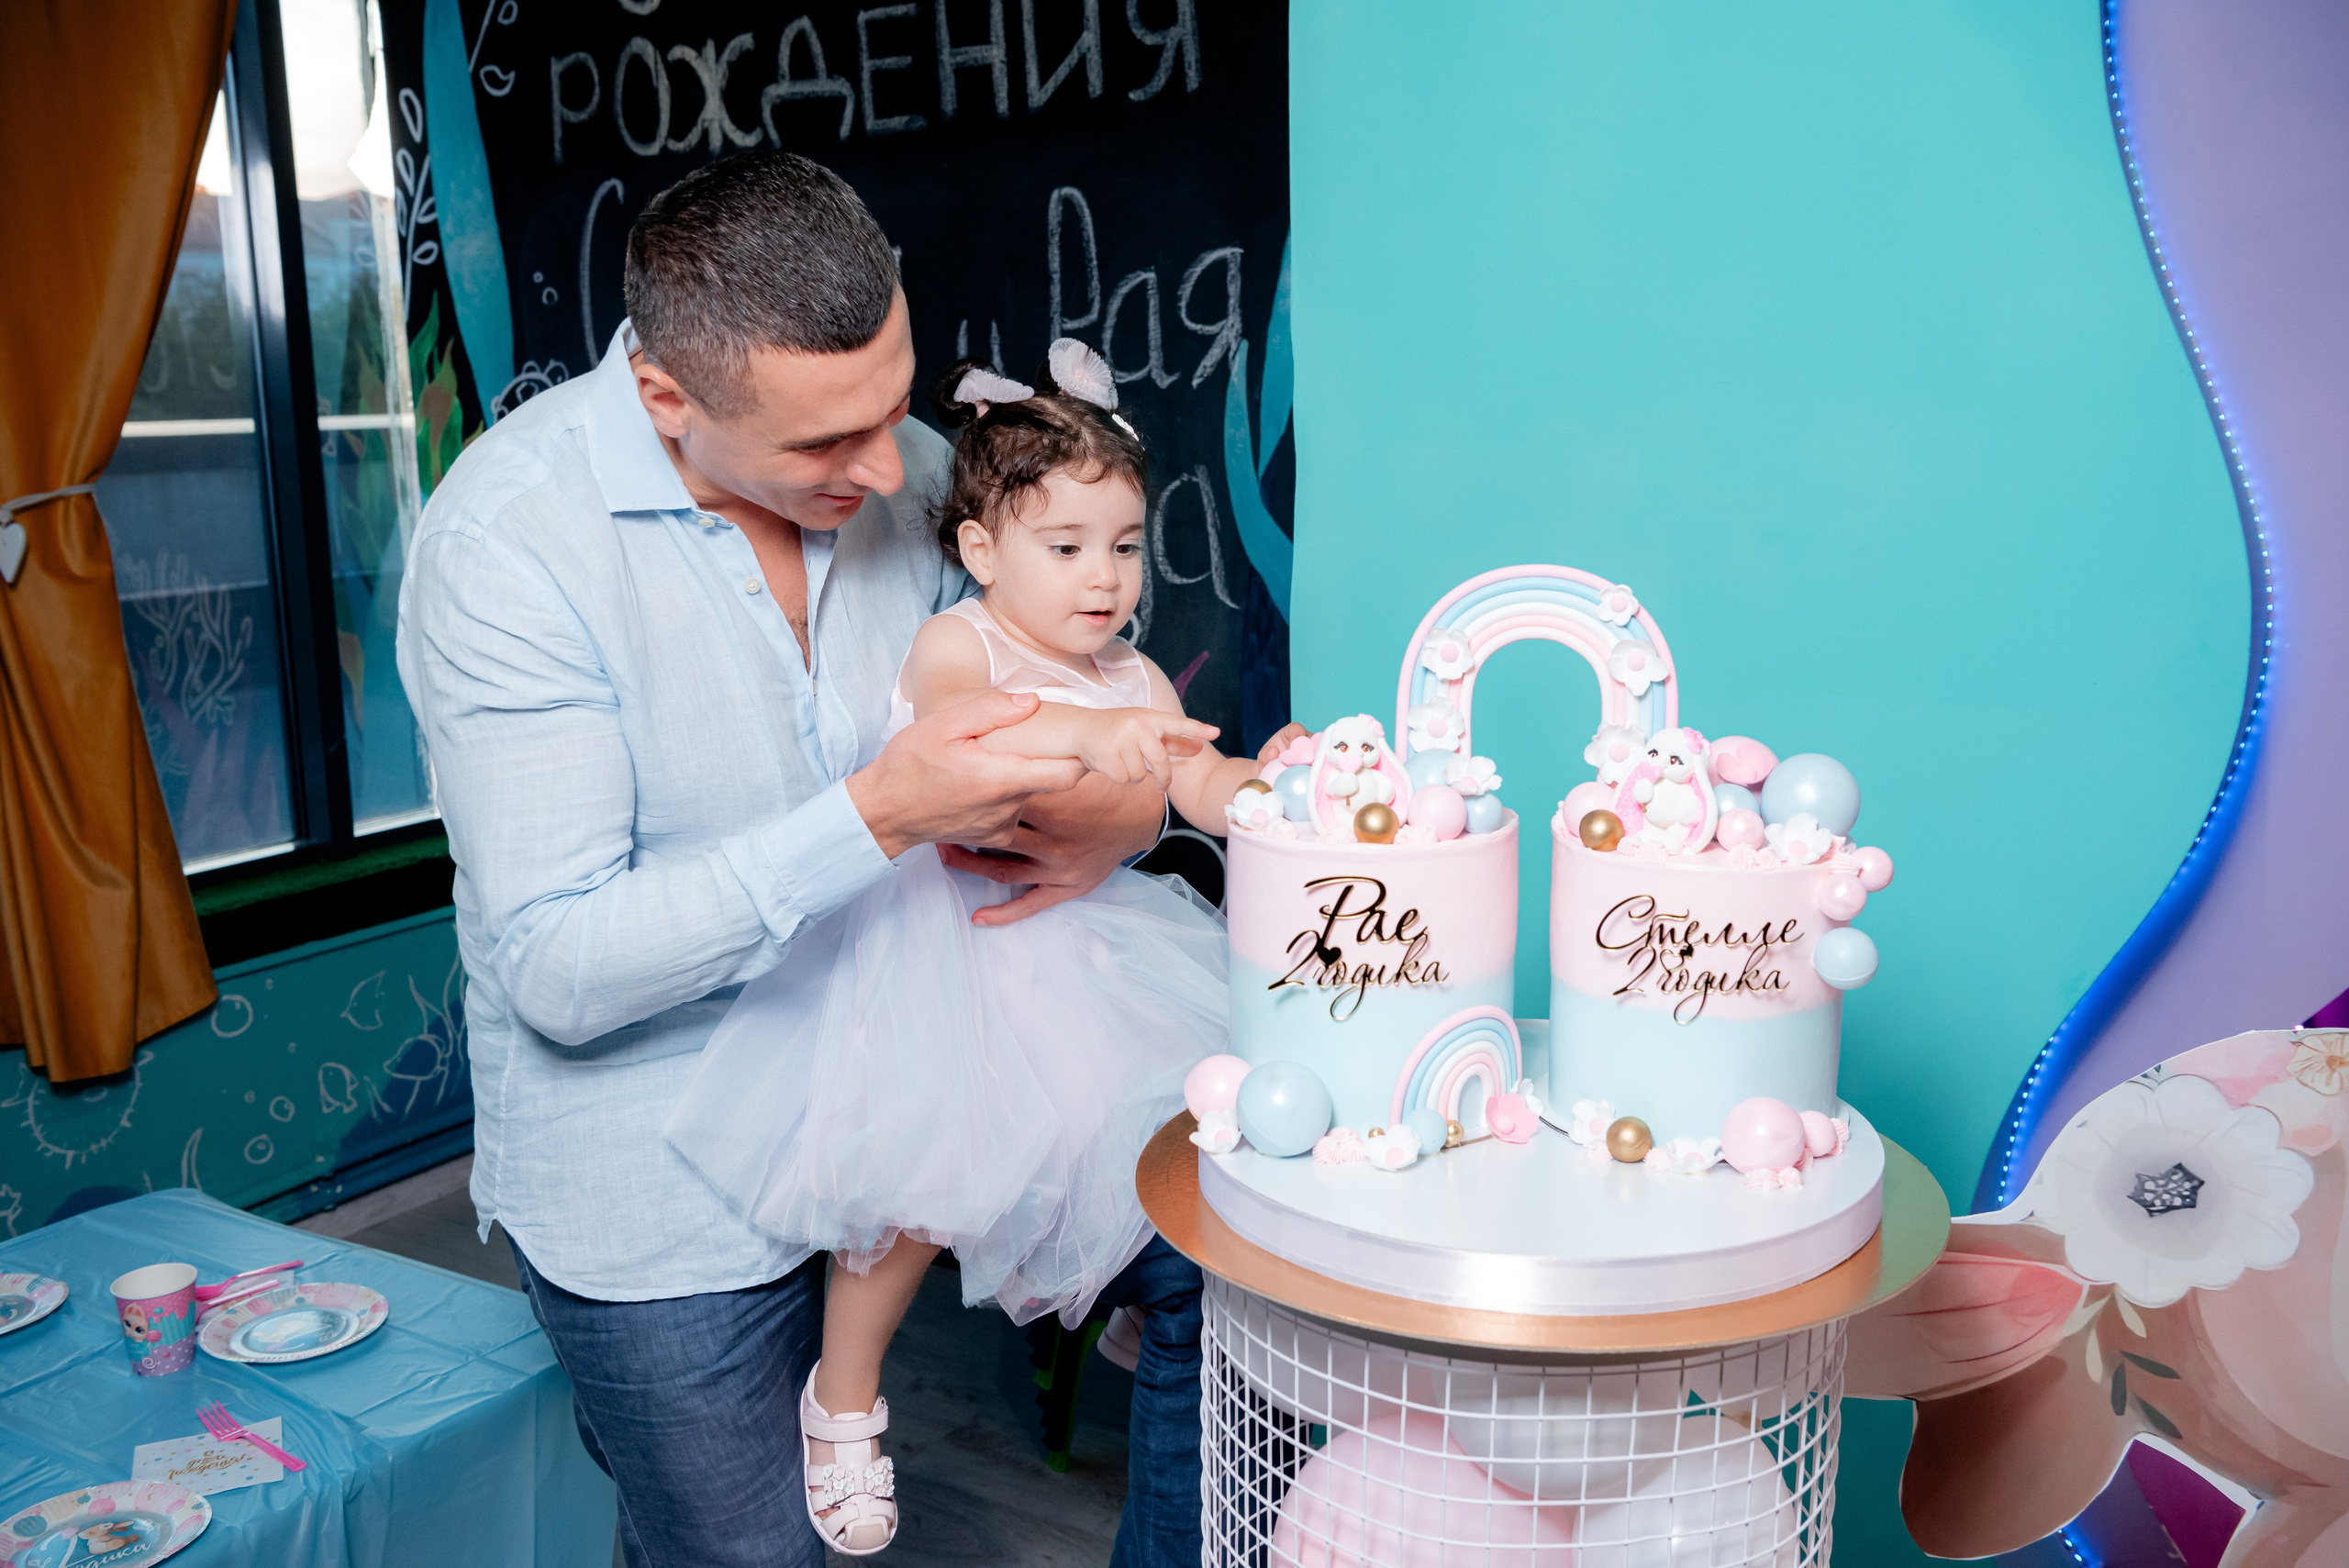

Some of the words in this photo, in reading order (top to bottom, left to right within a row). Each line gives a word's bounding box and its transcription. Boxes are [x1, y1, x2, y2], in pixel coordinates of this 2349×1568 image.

[1048, 186, 1245, 390] Рая
[1303, 875, 1429, 947] Рае
[1596, 895, 1805, 951] Стелле
[1612, 946, 1657, 996] 2
